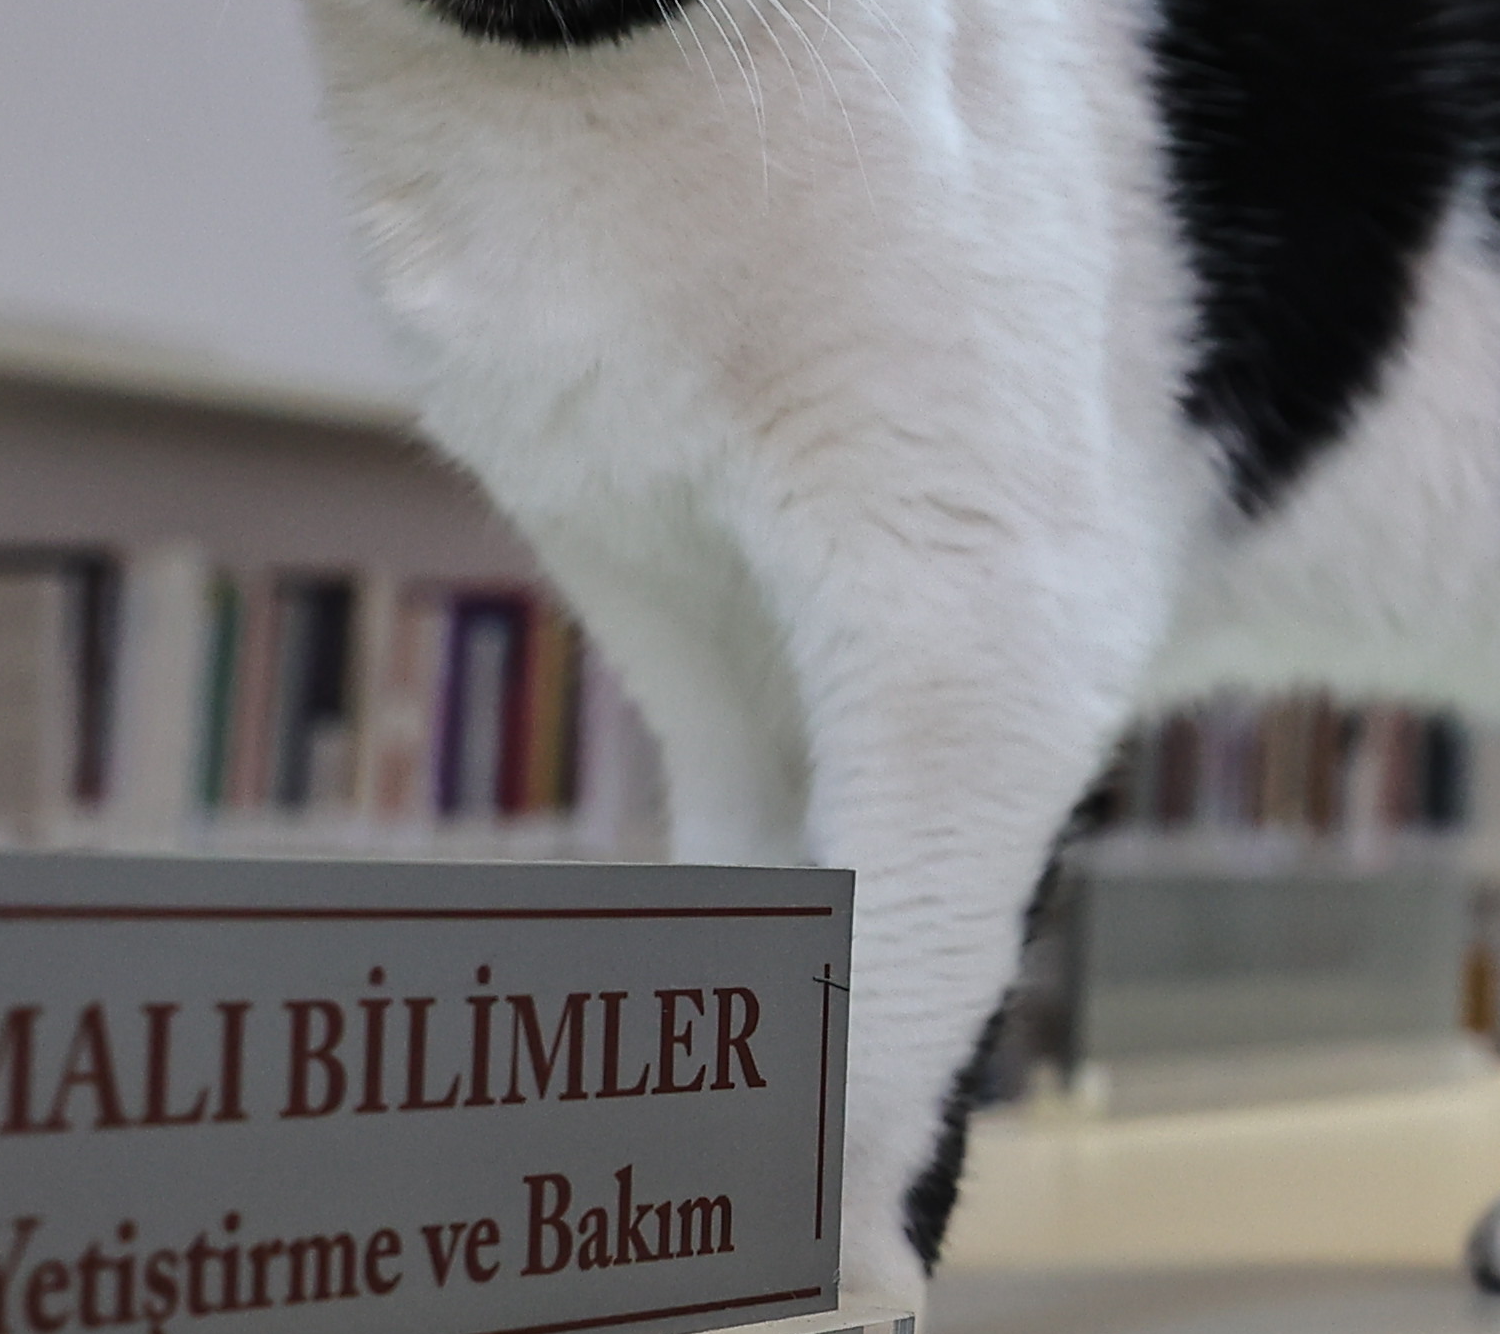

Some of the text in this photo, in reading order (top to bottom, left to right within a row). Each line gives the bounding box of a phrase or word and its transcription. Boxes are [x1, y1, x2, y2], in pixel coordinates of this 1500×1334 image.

[279, 966, 767, 1118] BİLİMLER
[421, 1216, 501, 1288] ve
[520, 1163, 735, 1277] Bakım
